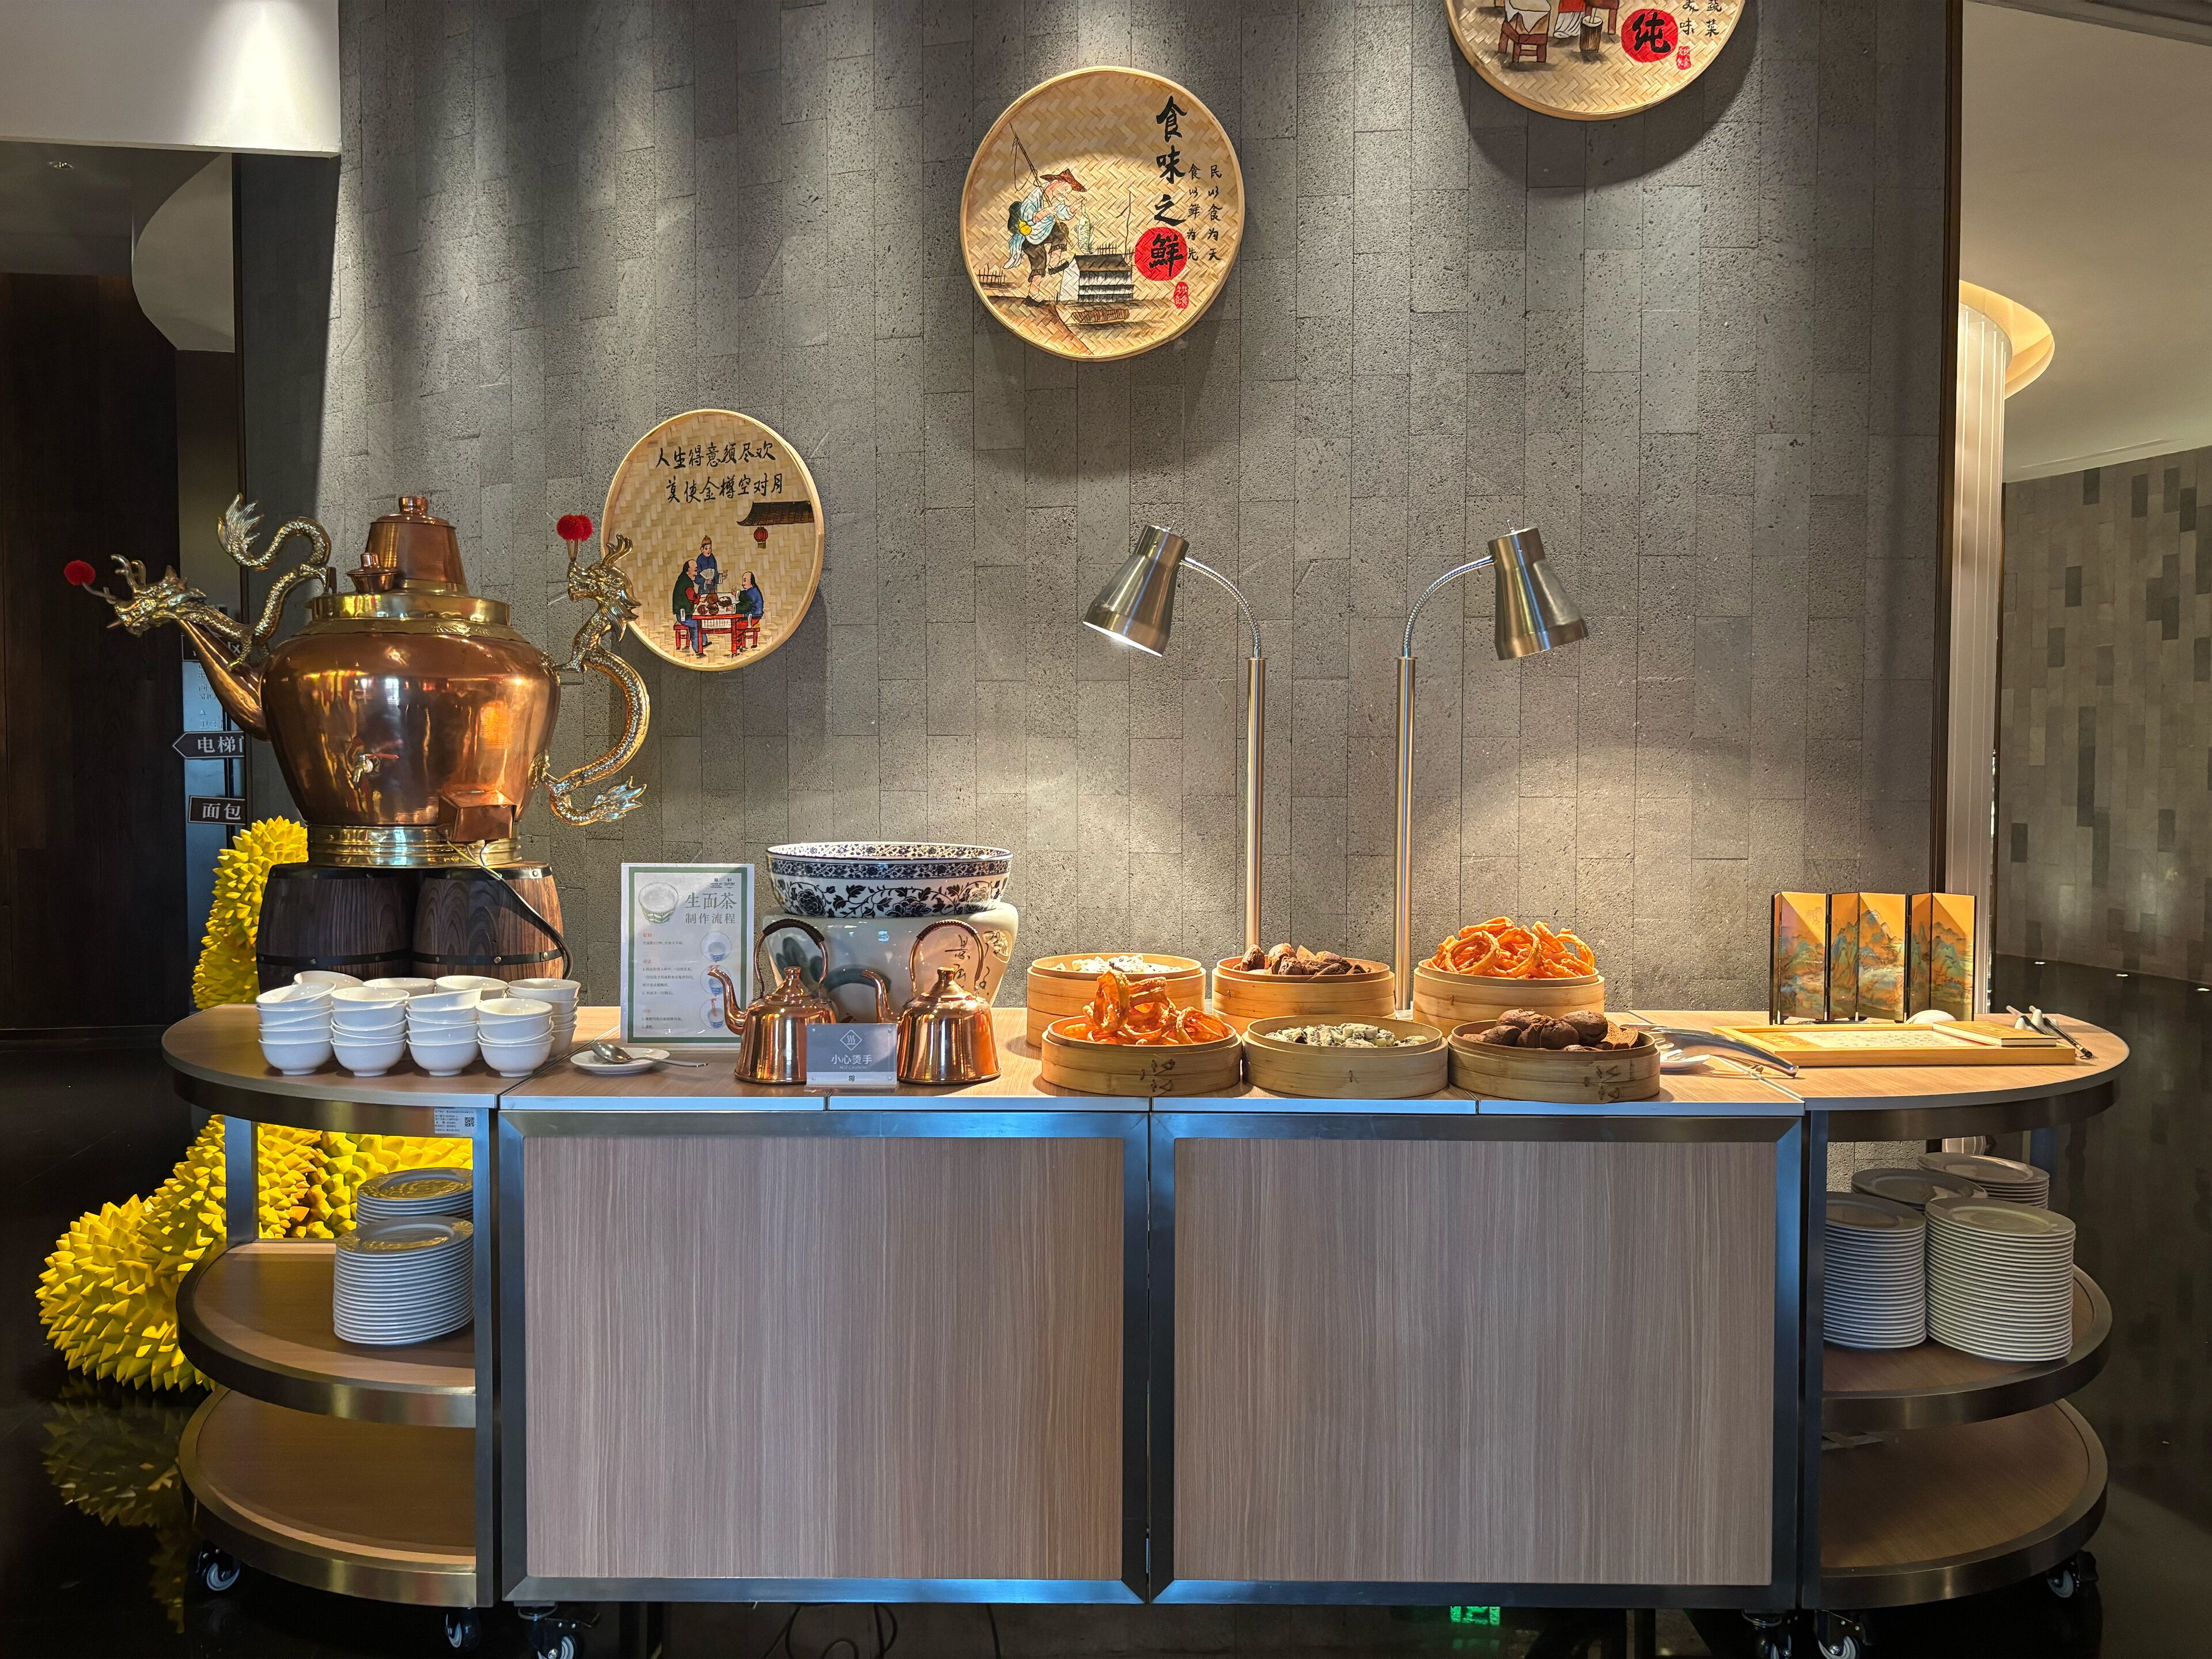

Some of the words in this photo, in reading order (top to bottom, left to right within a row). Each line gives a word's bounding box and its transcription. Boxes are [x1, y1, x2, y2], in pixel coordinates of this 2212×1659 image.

[1632, 12, 1671, 54] 纯
[1208, 164, 1223, 261] 民以食为天
[655, 440, 776, 469] 人生得意须尽欢
[665, 472, 783, 503] 莫使金樽空对月
[202, 802, 241, 820] 面包
[685, 891, 737, 910] 生面茶
[685, 913, 736, 924] 制作流程
[831, 1054, 873, 1065] 小心烫手
